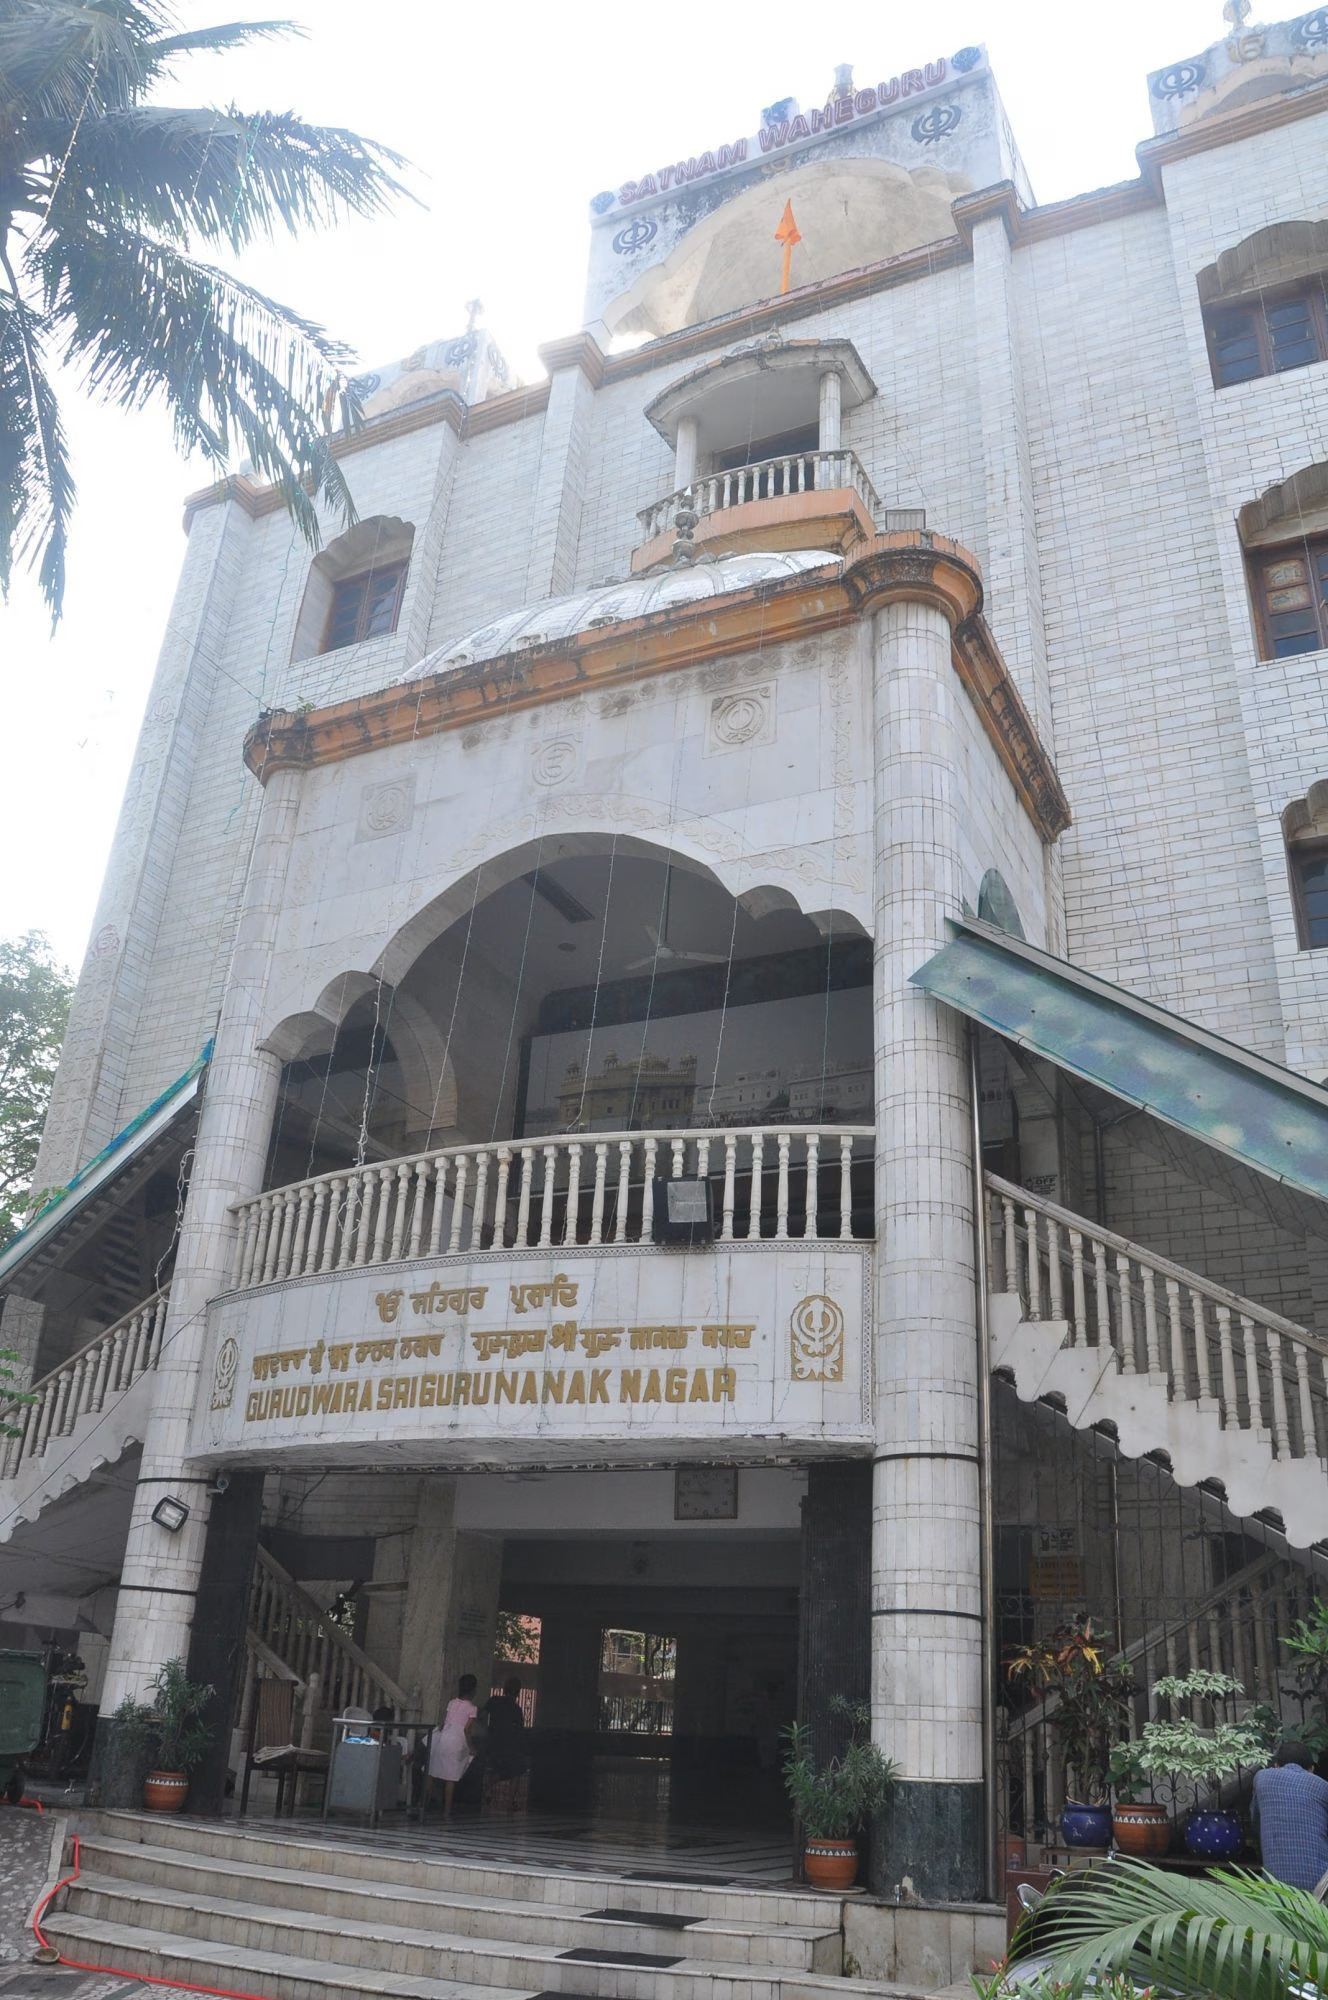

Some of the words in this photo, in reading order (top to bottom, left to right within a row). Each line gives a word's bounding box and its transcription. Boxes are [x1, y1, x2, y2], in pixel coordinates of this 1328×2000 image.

[618, 137, 748, 205] SATNAM
[757, 58, 947, 152] WAHEGURU
[510, 1273, 579, 1314] ਪ੍ਰਸਾਦਿ
[355, 1338, 399, 1363] ਨਾਨਕ
[400, 1334, 446, 1360] ਨਗਰ
[550, 1320, 577, 1351] श्री
[628, 1325, 698, 1350] नानक
[701, 1324, 757, 1350] नगर
[246, 1379, 373, 1422] GURUDWARA
[377, 1376, 418, 1411] SRI
[419, 1372, 492, 1407] GURU
[493, 1369, 612, 1405] NANAK
[620, 1367, 738, 1404] NAGAR
